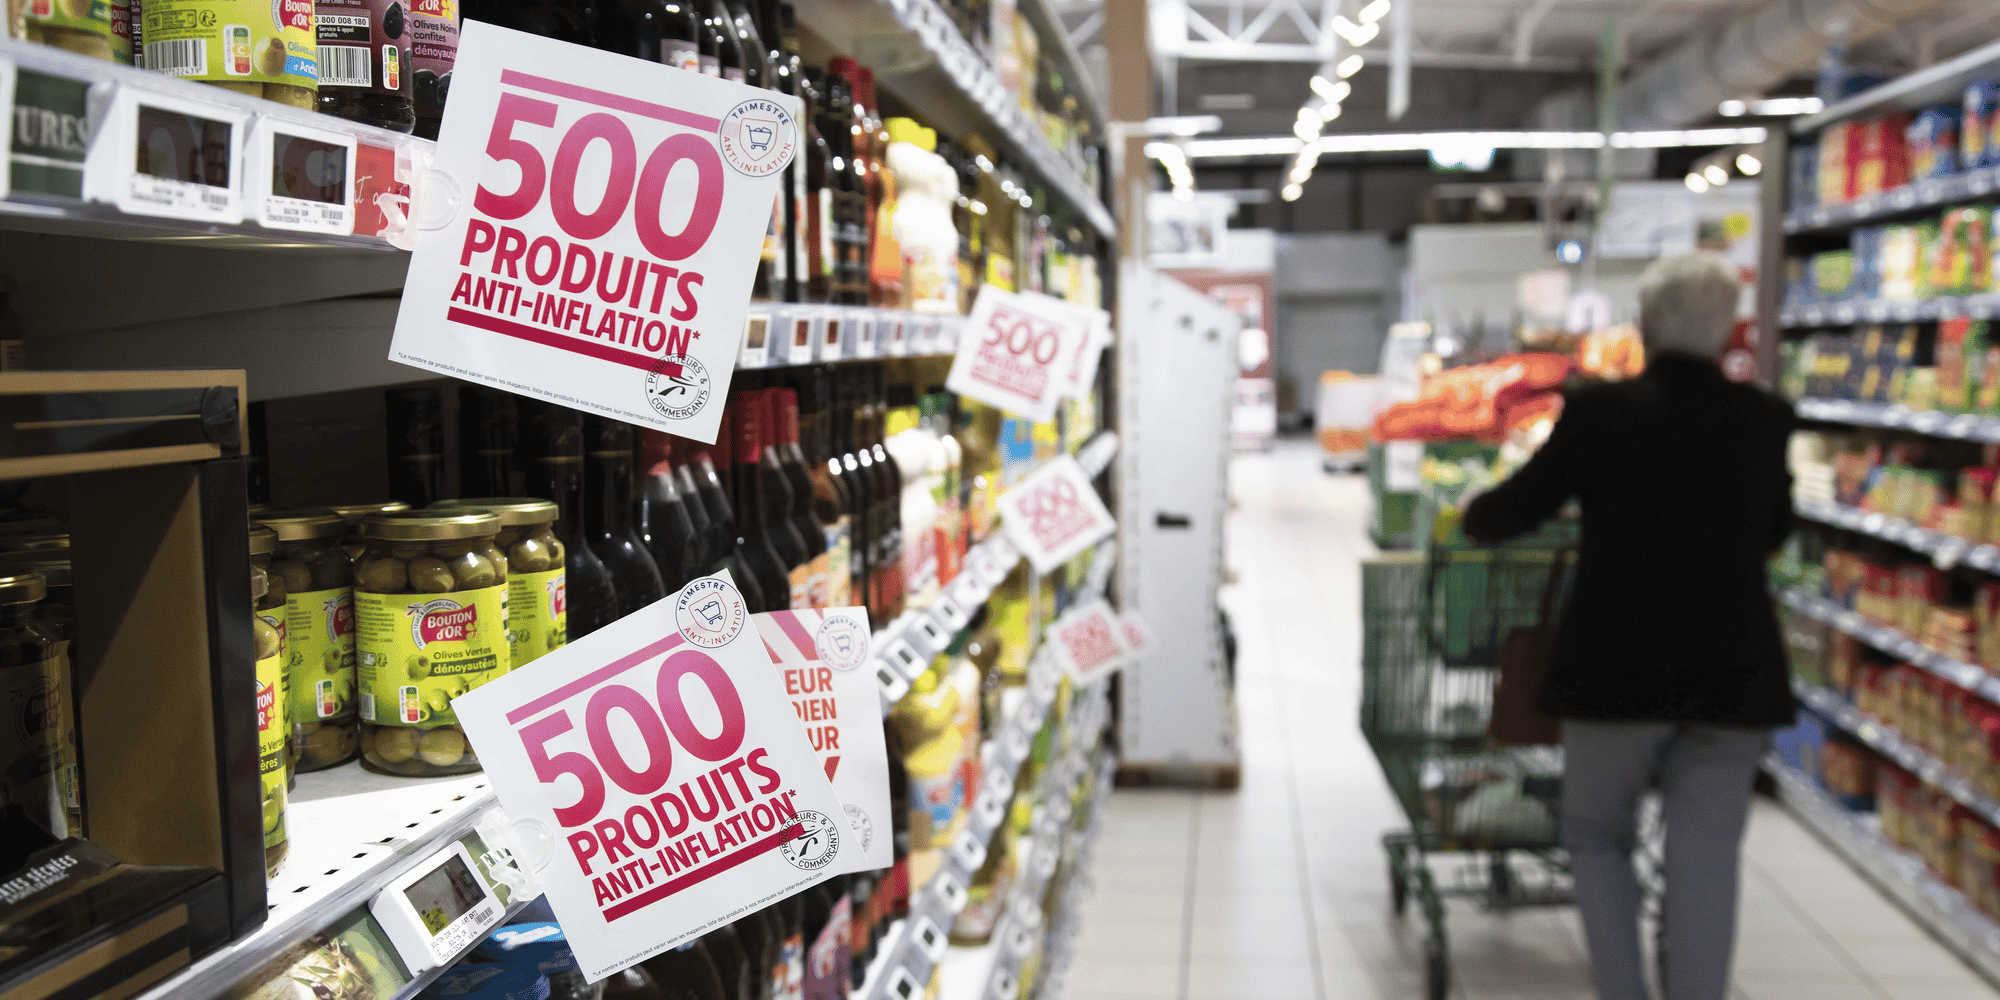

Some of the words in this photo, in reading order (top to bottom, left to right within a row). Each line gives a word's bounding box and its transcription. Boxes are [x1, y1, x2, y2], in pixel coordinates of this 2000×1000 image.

[318, 25, 337, 33] Service
[321, 15, 336, 24] 800
[338, 16, 352, 25] 008
[355, 17, 367, 26] 180
[413, 19, 440, 31] Olives
[413, 31, 447, 43] confites
[731, 102, 789, 126] TRIMESTRE
[723, 135, 792, 173] ANTI-INFLATION
[473, 91, 725, 262] 500
[459, 218, 704, 322] PRODUITS
[978, 306, 1061, 367] 500
[648, 355, 703, 384] PRODUCTEURS
[407, 354, 427, 364] nombre
[434, 361, 456, 372] produits
[456, 366, 468, 376] peut
[469, 370, 484, 379] varier
[484, 374, 498, 383] selon
[506, 380, 531, 392] magasins,
[532, 386, 543, 395] liste
[543, 390, 553, 398] des
[553, 393, 575, 403] produits
[580, 399, 590, 407] nos
[590, 401, 613, 413] marques
[623, 410, 667, 426] intermarché.com
[651, 389, 708, 418] COMMERÇANTS
[678, 581, 726, 612] TRIMESTRE
[427, 610, 473, 629] BOUTON
[436, 625, 463, 640] d'OR
[684, 600, 742, 645] ANTI-INFLATION
[820, 617, 858, 635] TRIMESTRE
[433, 649, 464, 660] Olives
[465, 646, 492, 657] Vertes
[433, 659, 496, 674] dénoyautées
[784, 666, 833, 695] EUR
[256, 691, 273, 710] TON
[518, 649, 746, 828] 500
[806, 725, 840, 752] UR
[259, 757, 278, 772] ères
[566, 747, 782, 877] PRODUITS
[780, 812, 818, 855] PRODUCTEURS
[798, 826, 838, 869] COMMERÇANTS
[601, 962, 619, 974] nombre
[624, 952, 643, 964] produits
[642, 947, 654, 956] peut
[653, 941, 667, 952] varier
[666, 936, 679, 945] selon
[707, 919, 718, 927] liste
[717, 915, 726, 923] des
[725, 907, 745, 919] produits
[748, 902, 758, 910] nos
[757, 892, 778, 905] marques
[776, 888, 786, 896] sur
[785, 872, 824, 893] intermarché.com
